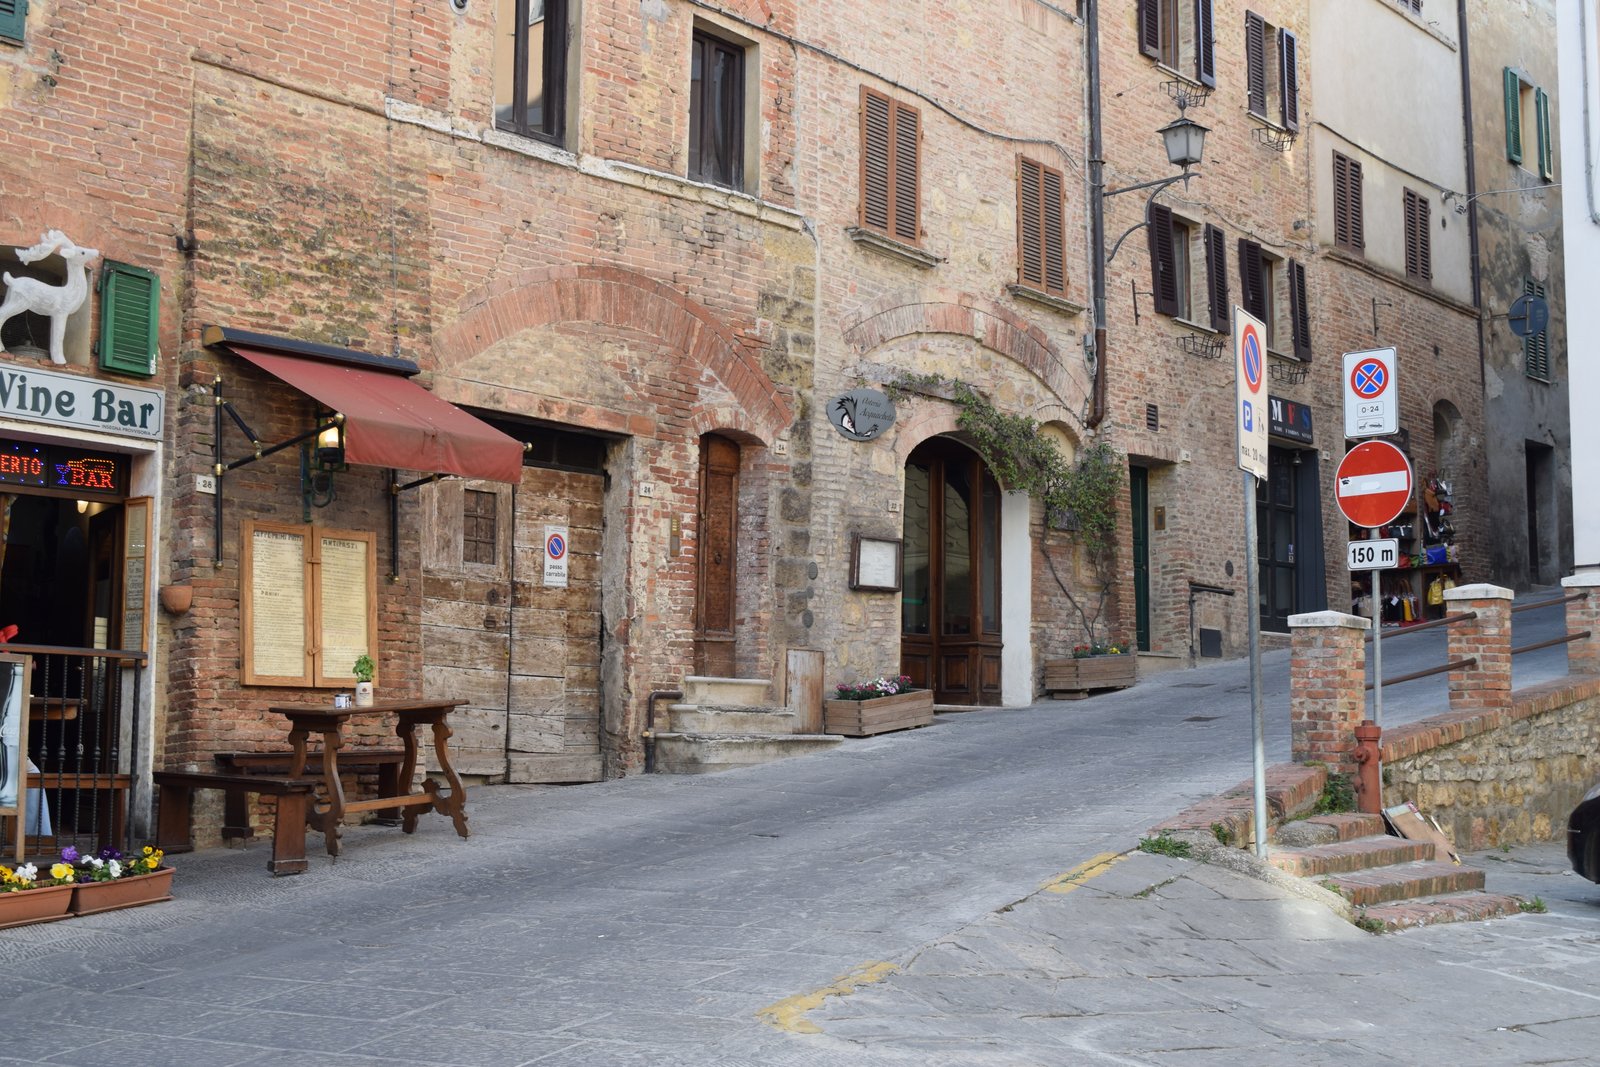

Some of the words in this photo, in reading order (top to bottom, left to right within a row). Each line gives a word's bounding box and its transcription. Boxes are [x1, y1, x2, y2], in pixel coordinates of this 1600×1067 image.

[92, 388, 155, 429] Bar
[71, 468, 115, 489] BAR
[202, 480, 212, 488] 28
[322, 540, 358, 549] ANTIPASTI
[1352, 547, 1374, 563] 150
[1381, 549, 1393, 561] m
